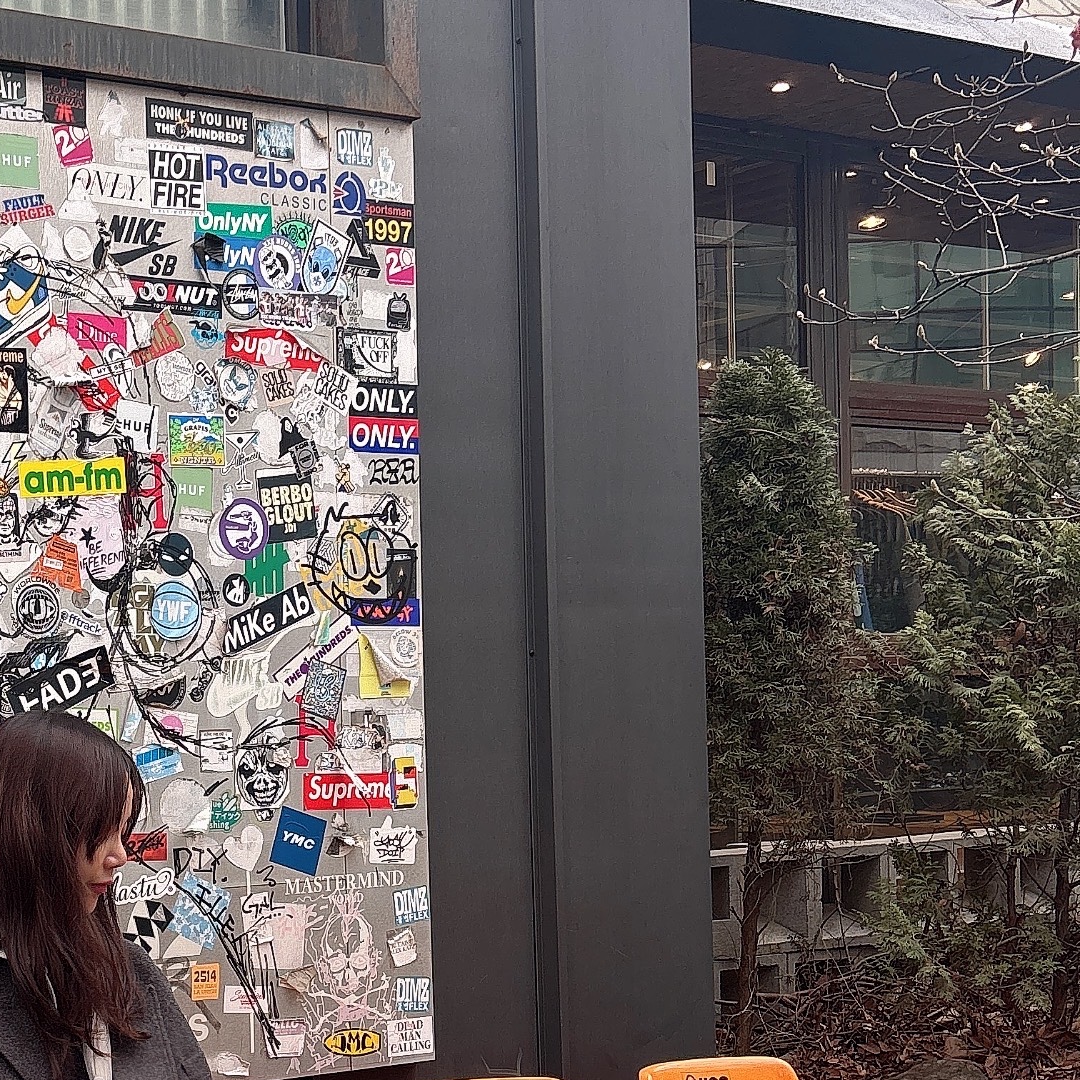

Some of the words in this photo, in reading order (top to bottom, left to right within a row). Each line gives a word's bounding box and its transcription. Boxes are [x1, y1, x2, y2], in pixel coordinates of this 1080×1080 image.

[150, 103, 182, 122] HONK
[198, 111, 222, 129] YOU
[224, 114, 248, 131] LIVE
[155, 121, 176, 136] THE
[186, 128, 246, 145] HUNDREDS
[338, 130, 371, 153] DIMZ
[2, 153, 32, 167] HUF
[153, 154, 200, 181] HOT
[206, 153, 327, 193] Reebok
[154, 183, 202, 209] FIRE
[261, 192, 328, 212] CLASSIC
[198, 210, 268, 235] OnlyNY
[366, 204, 412, 218] Sportsman
[110, 215, 166, 245] NIKE
[366, 218, 412, 244] 1997
[148, 254, 178, 275] SB
[361, 337, 390, 350] FUCK
[354, 391, 414, 415] ONLY.
[353, 425, 414, 449] ONLY.
[24, 463, 122, 494] am-fm
[178, 484, 206, 497] HUF
[261, 484, 312, 507] BERBO
[154, 599, 191, 621] YWF
[279, 593, 310, 626] Ab
[282, 829, 316, 850] YMC
[284, 870, 405, 897] MASTERMIND
[395, 887, 428, 913] DIMZ
[408, 909, 429, 922] FLEX
[396, 978, 430, 1001] DIMZ
[408, 1000, 429, 1012] FLEX
[390, 1040, 432, 1053] CALLING
[400, 1031, 422, 1041] MAN
